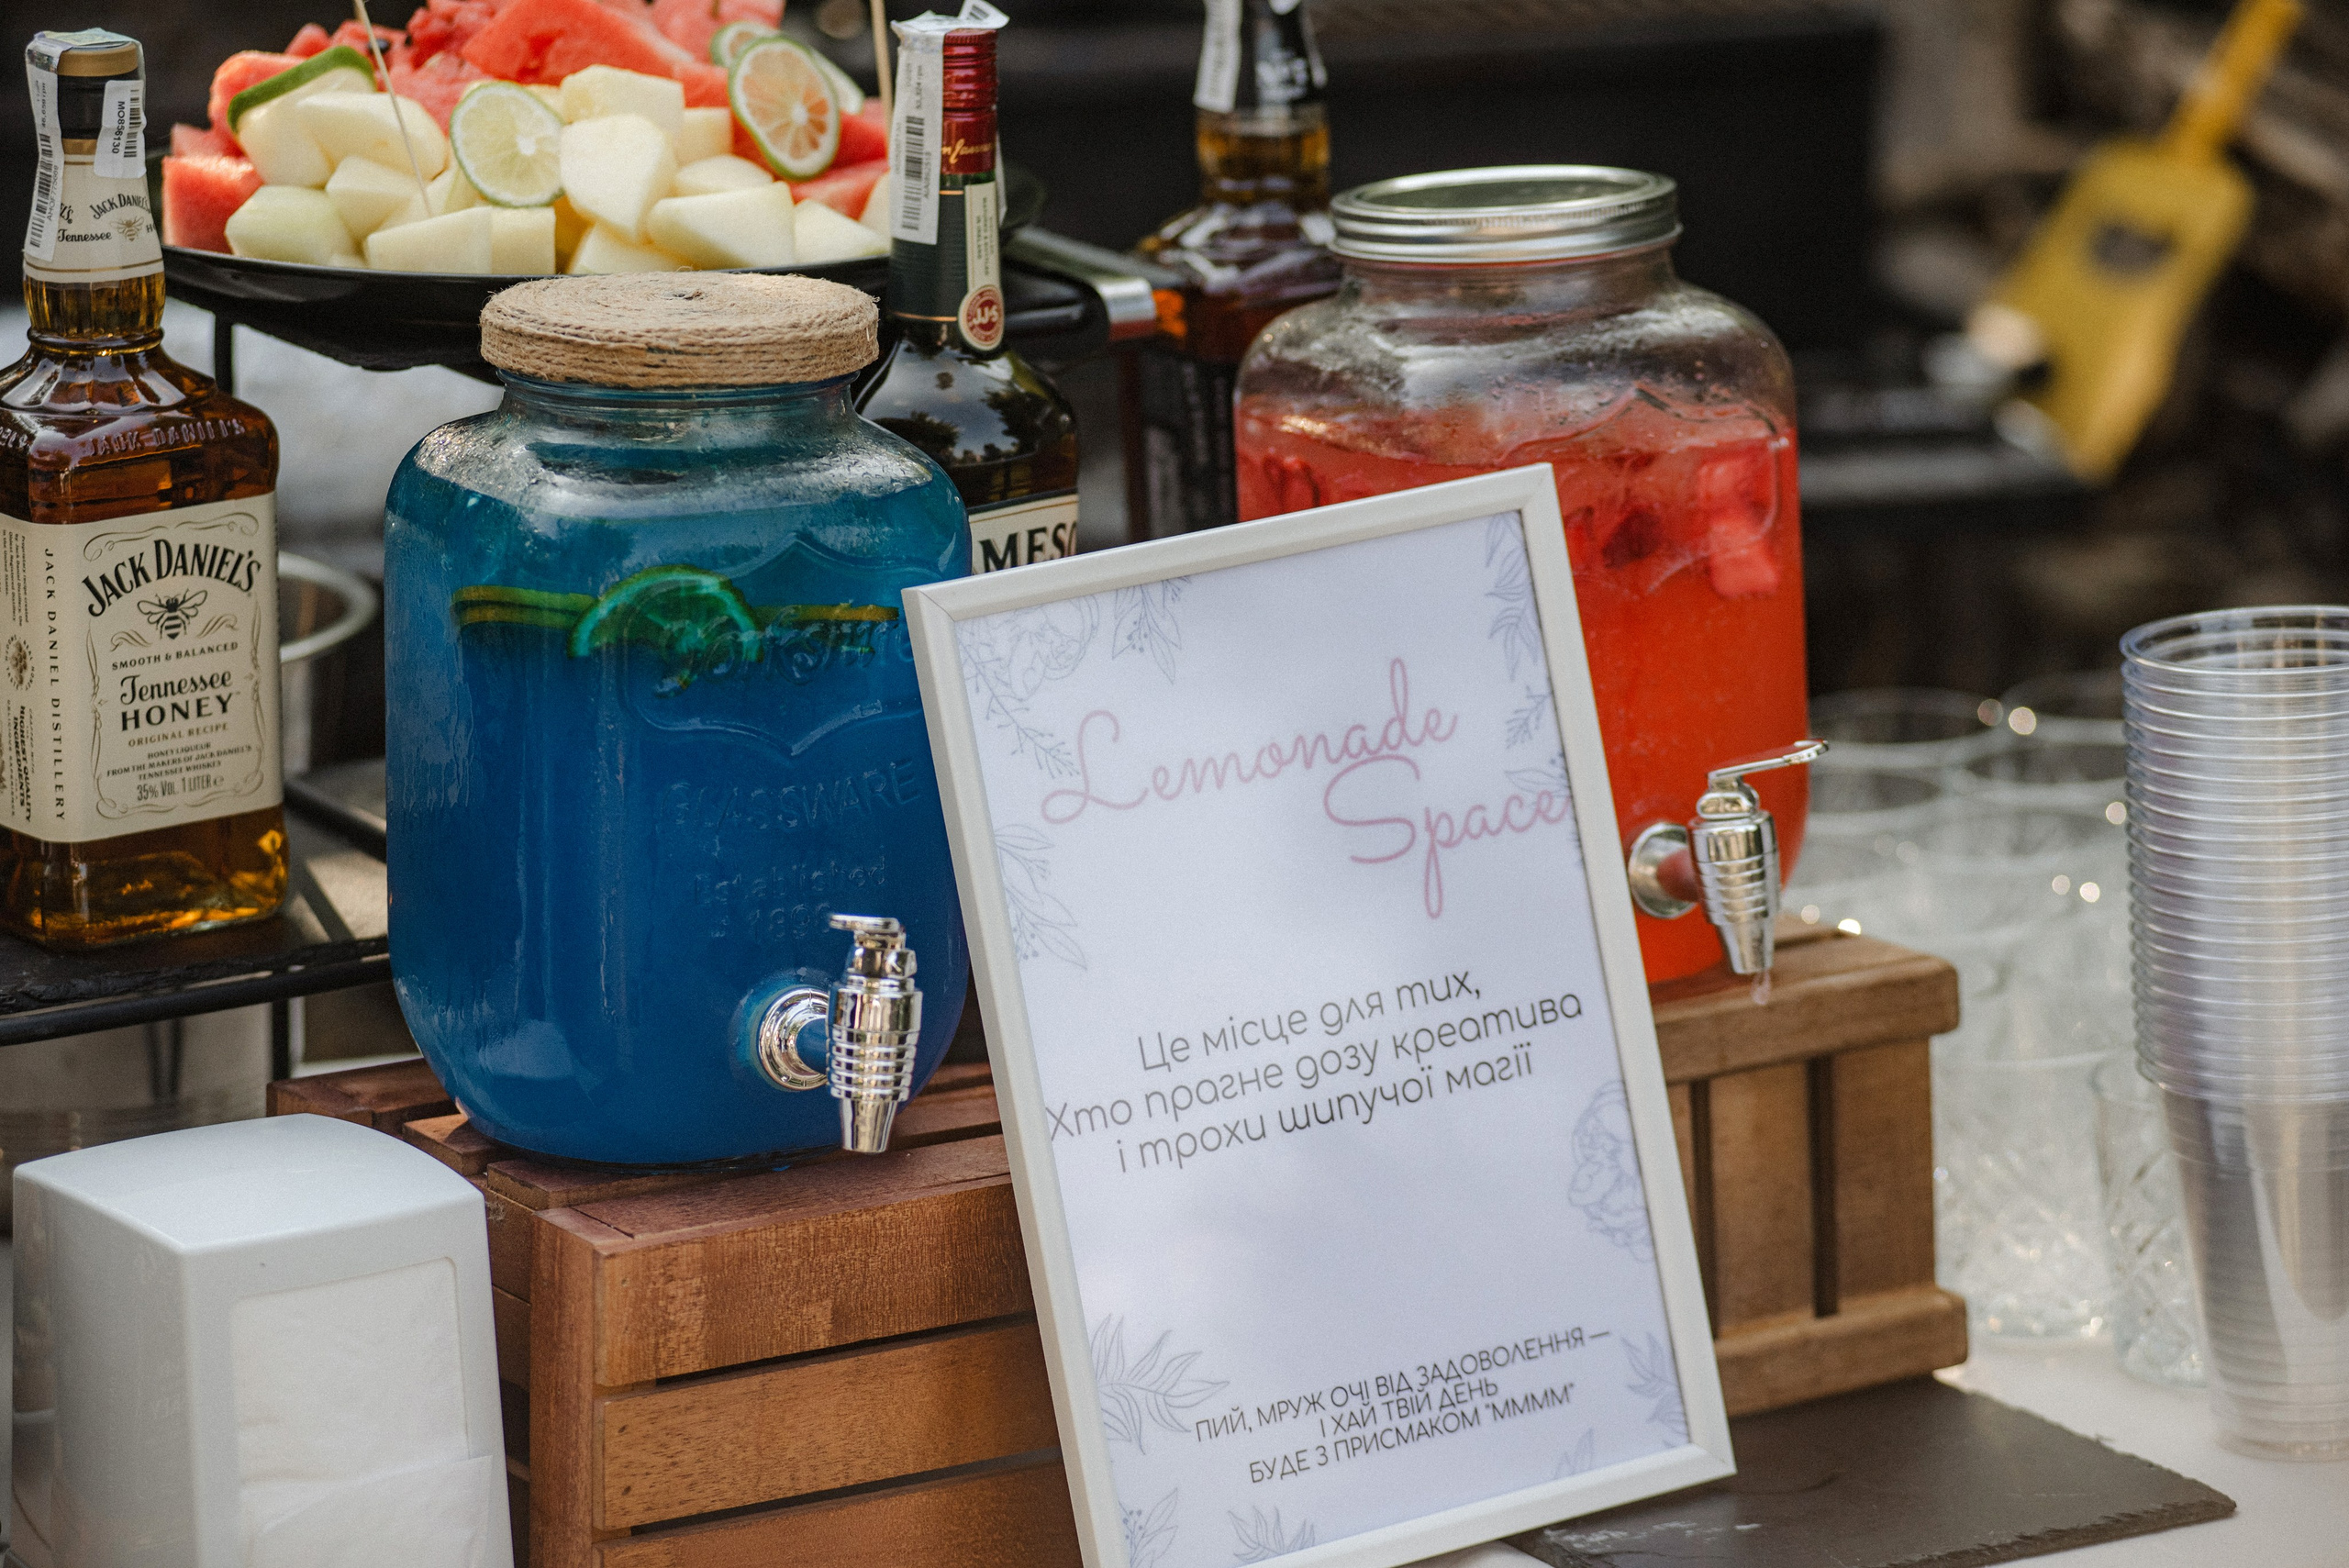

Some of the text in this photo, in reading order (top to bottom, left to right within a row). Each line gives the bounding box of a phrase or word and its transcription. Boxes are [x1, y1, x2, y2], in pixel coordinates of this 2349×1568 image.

[58, 228, 112, 242] Tennessee
[90, 197, 118, 219] JACK
[82, 539, 262, 617] JACK DANIEL'S
[973, 520, 1077, 575] MES
[44, 548, 65, 820] JACK DANIEL DISTILLERY
[112, 641, 239, 671] SMOOTH & BALANCED
[120, 671, 232, 706] Tennessee
[121, 693, 232, 731] HONEY
[13, 716, 25, 807] INGREDIENTS
[19, 706, 31, 823] HIGHEST QUALITY
[106, 766, 130, 777] FROM
[149, 758, 183, 769] MAKERS
[184, 755, 193, 763] OF
[195, 751, 216, 761] JACK
[128, 722, 228, 748] ORIGINAL RECIPE
[148, 742, 211, 760] HONEY LIQUEUR
[1041, 657, 1458, 825] Lemonade
[137, 783, 160, 801] 35%
[182, 776, 186, 793] 1
[188, 774, 212, 791] LITER
[139, 760, 222, 781] TENNESSEE WHISKEY
[1323, 753, 1574, 919] Space
[1138, 971, 1481, 1073] Це місце для тих,
[1045, 994, 1582, 1141] Хто прагне дозу креатива
[1116, 1041, 1532, 1173] і трохи шипучої магії
[1196, 1407, 1252, 1442] ПИЙ,
[1256, 1391, 1326, 1427] МРУЖ
[1330, 1379, 1370, 1407] ОЧІ
[1375, 1371, 1413, 1397] ВІД
[1417, 1326, 1586, 1387] ЗАДОВОЛЕННЯ
[1319, 1377, 1498, 1438] І ХАЙ ТВІЙ ДЕНЬ
[1249, 1449, 1311, 1484] БУДЕ
[1334, 1407, 1481, 1462] ПРИСМАКОМ
